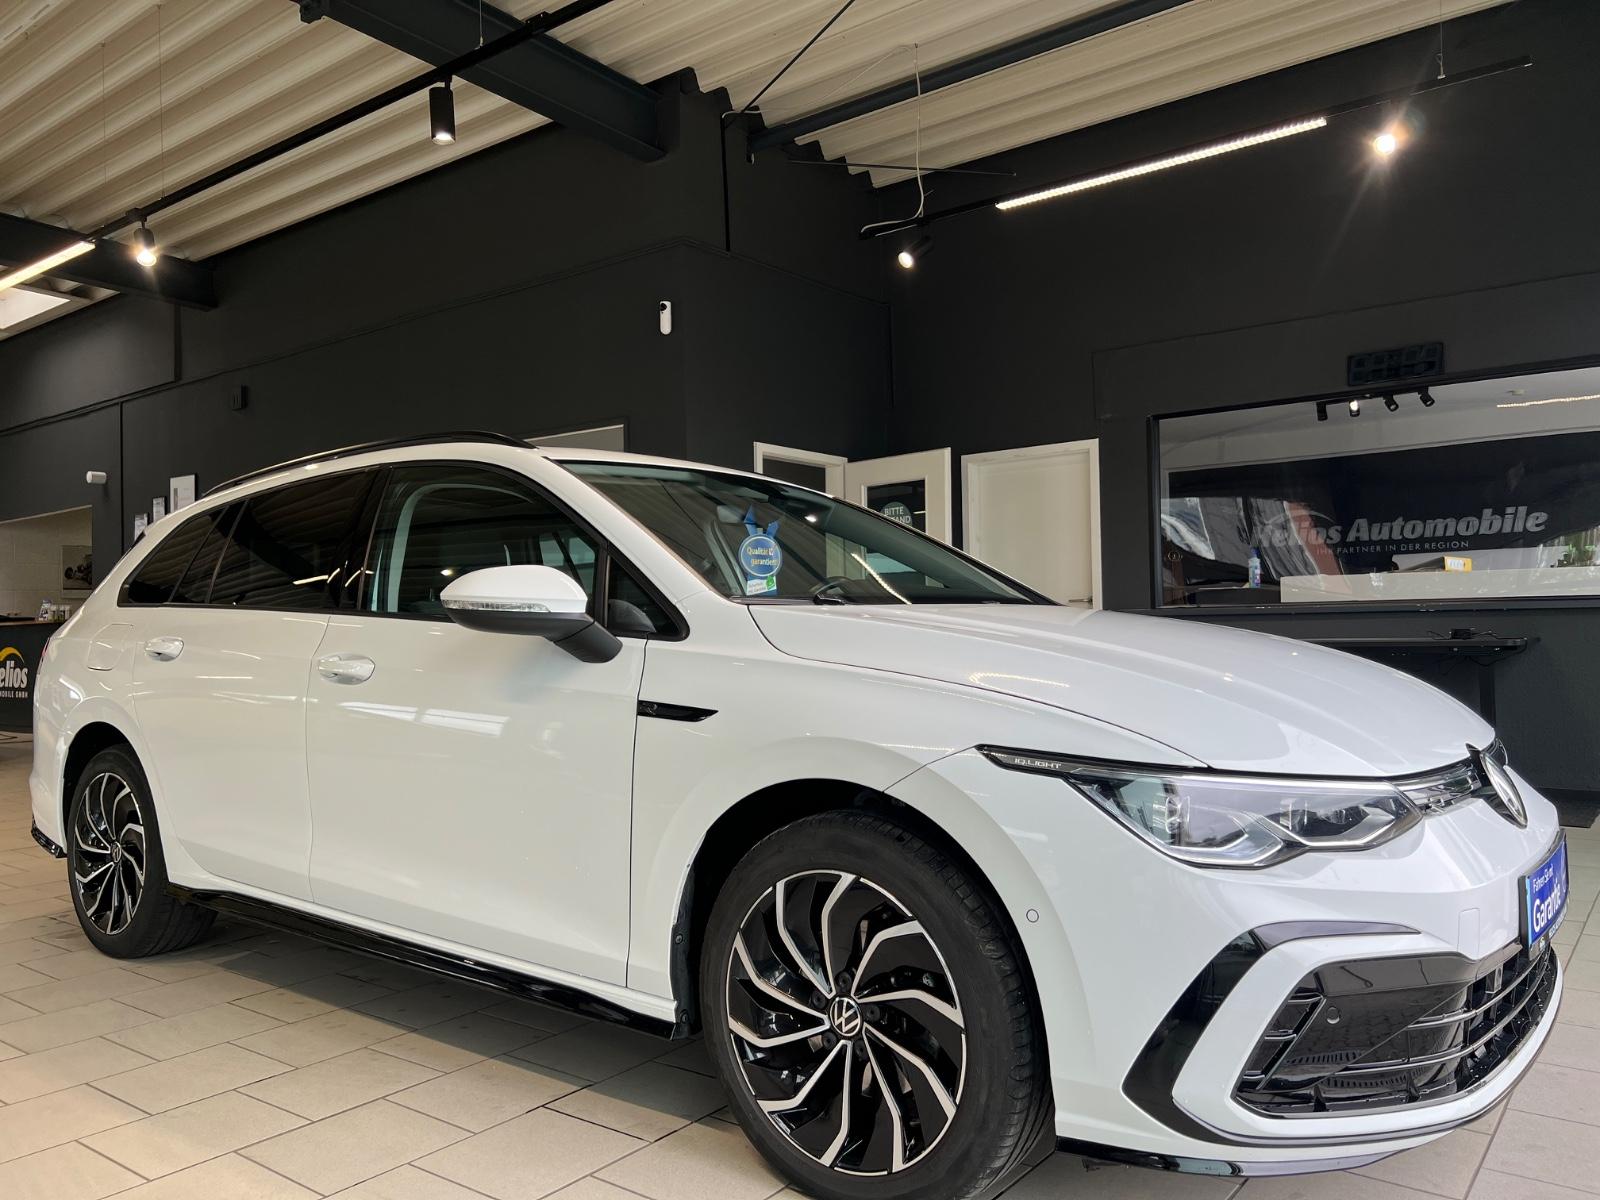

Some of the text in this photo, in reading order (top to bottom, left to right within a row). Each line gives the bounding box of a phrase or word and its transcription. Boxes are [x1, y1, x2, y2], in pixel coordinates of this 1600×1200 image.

[884, 506, 904, 516] BITTE
[1346, 505, 1549, 542] Automobile
[1337, 544, 1381, 554] PARTNER
[1401, 543, 1421, 551] DER
[1424, 540, 1469, 550] REGION
[1014, 758, 1062, 769] IQ.LIGHT
[1533, 879, 1560, 933] Garantie
